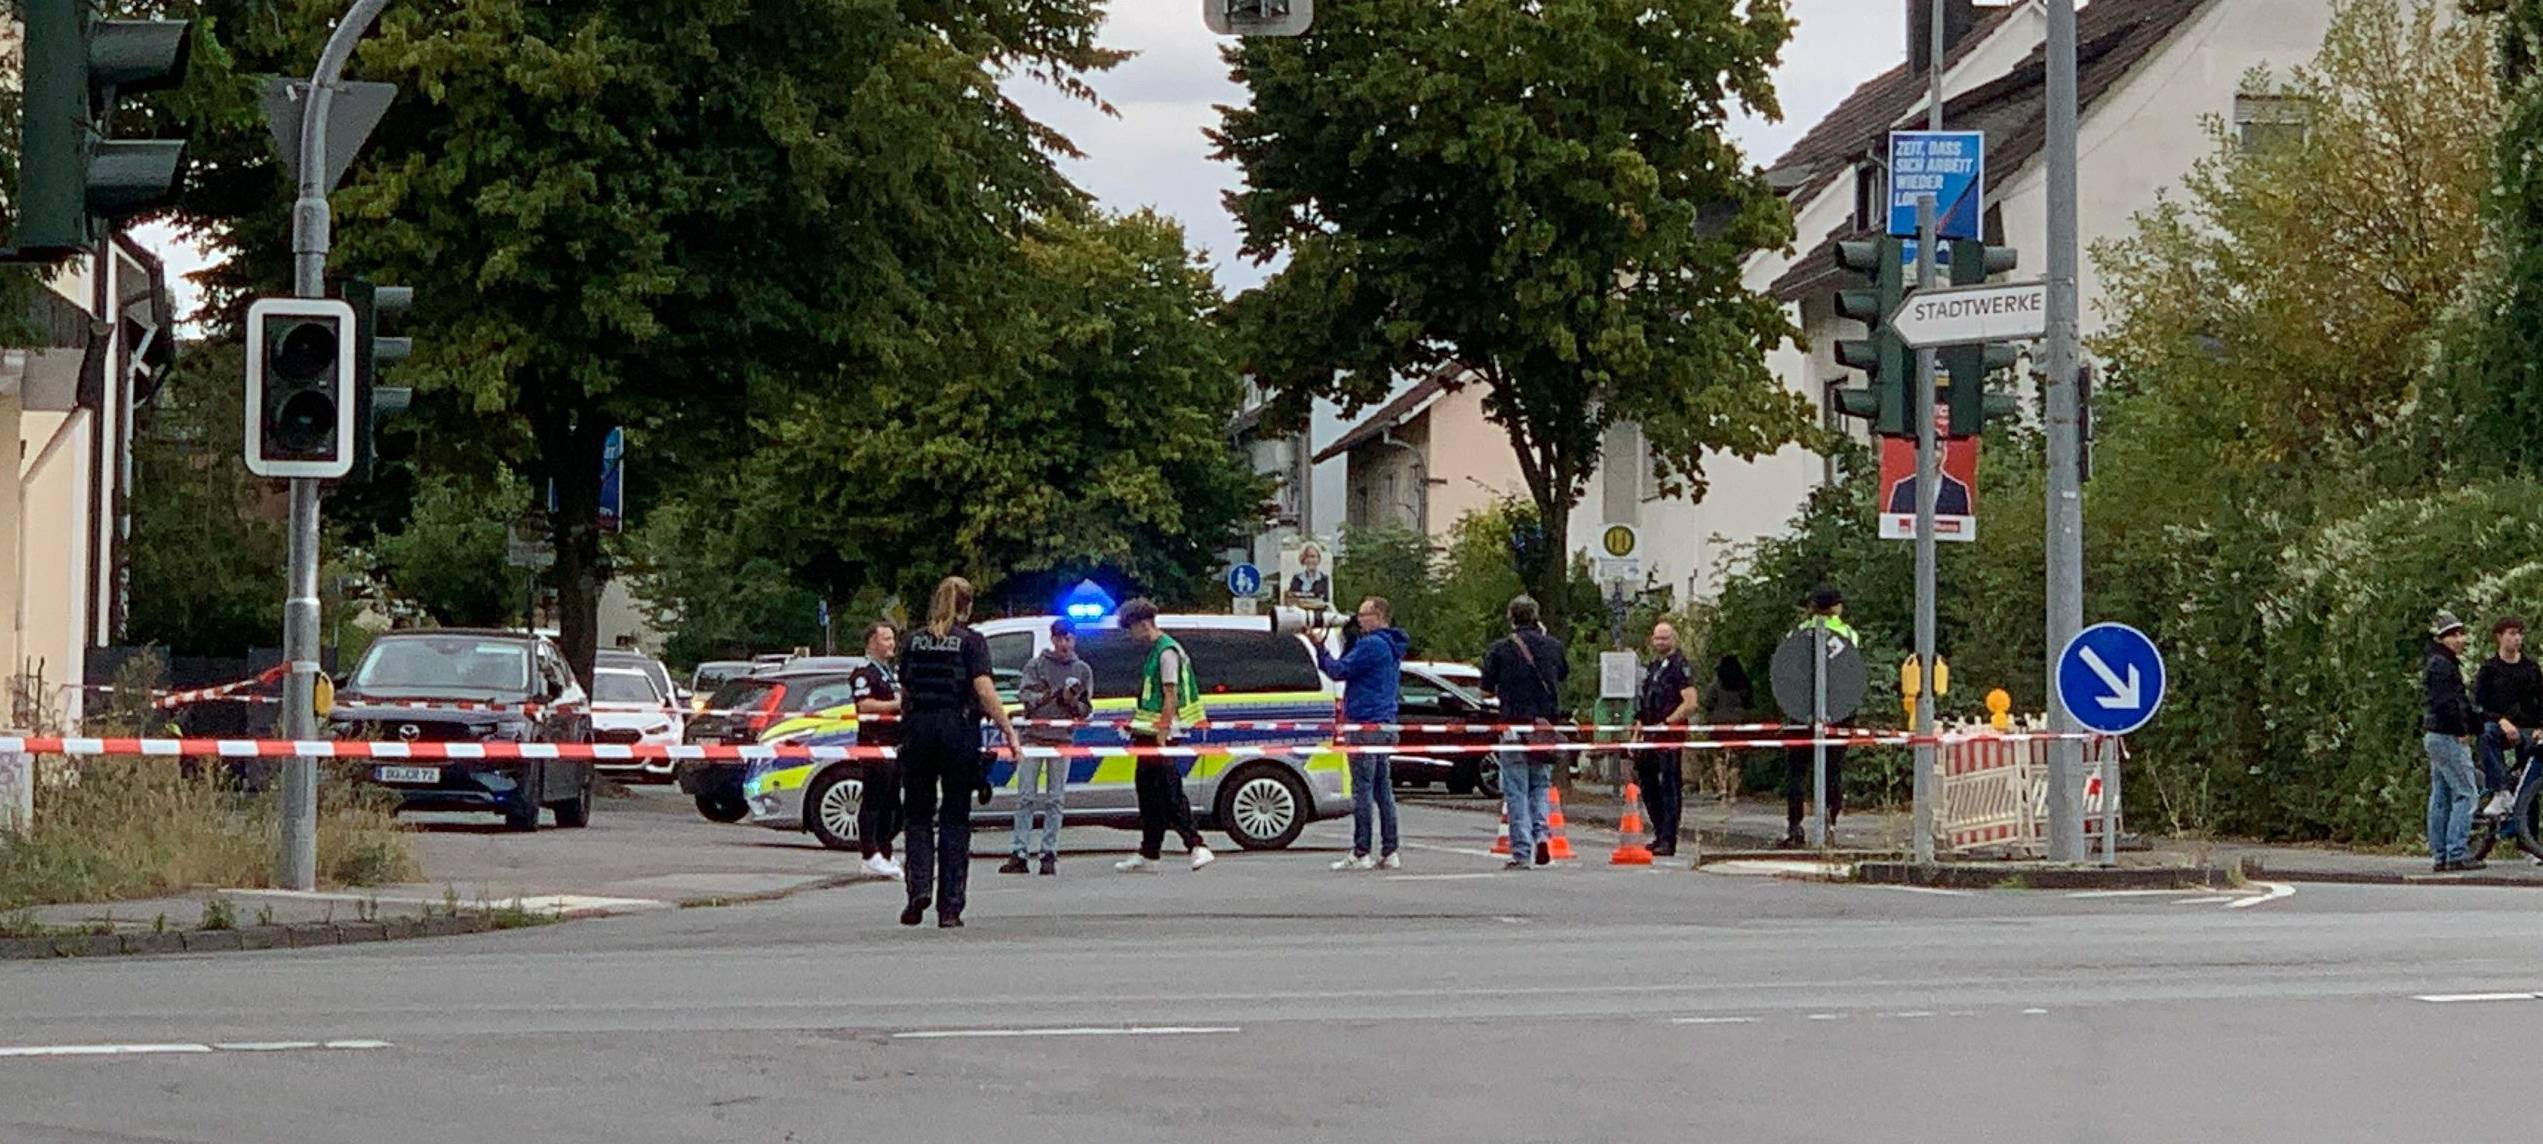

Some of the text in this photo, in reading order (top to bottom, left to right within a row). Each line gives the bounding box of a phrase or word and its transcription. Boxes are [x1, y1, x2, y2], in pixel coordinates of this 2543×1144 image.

[1895, 141, 1961, 156] ZEIT, DASS
[1894, 158, 1973, 173] SICH ARBEIT
[1895, 175, 1943, 189] WIEDER
[1915, 293, 2041, 321] STADTWERKE
[911, 636, 962, 651] POLIZEI
